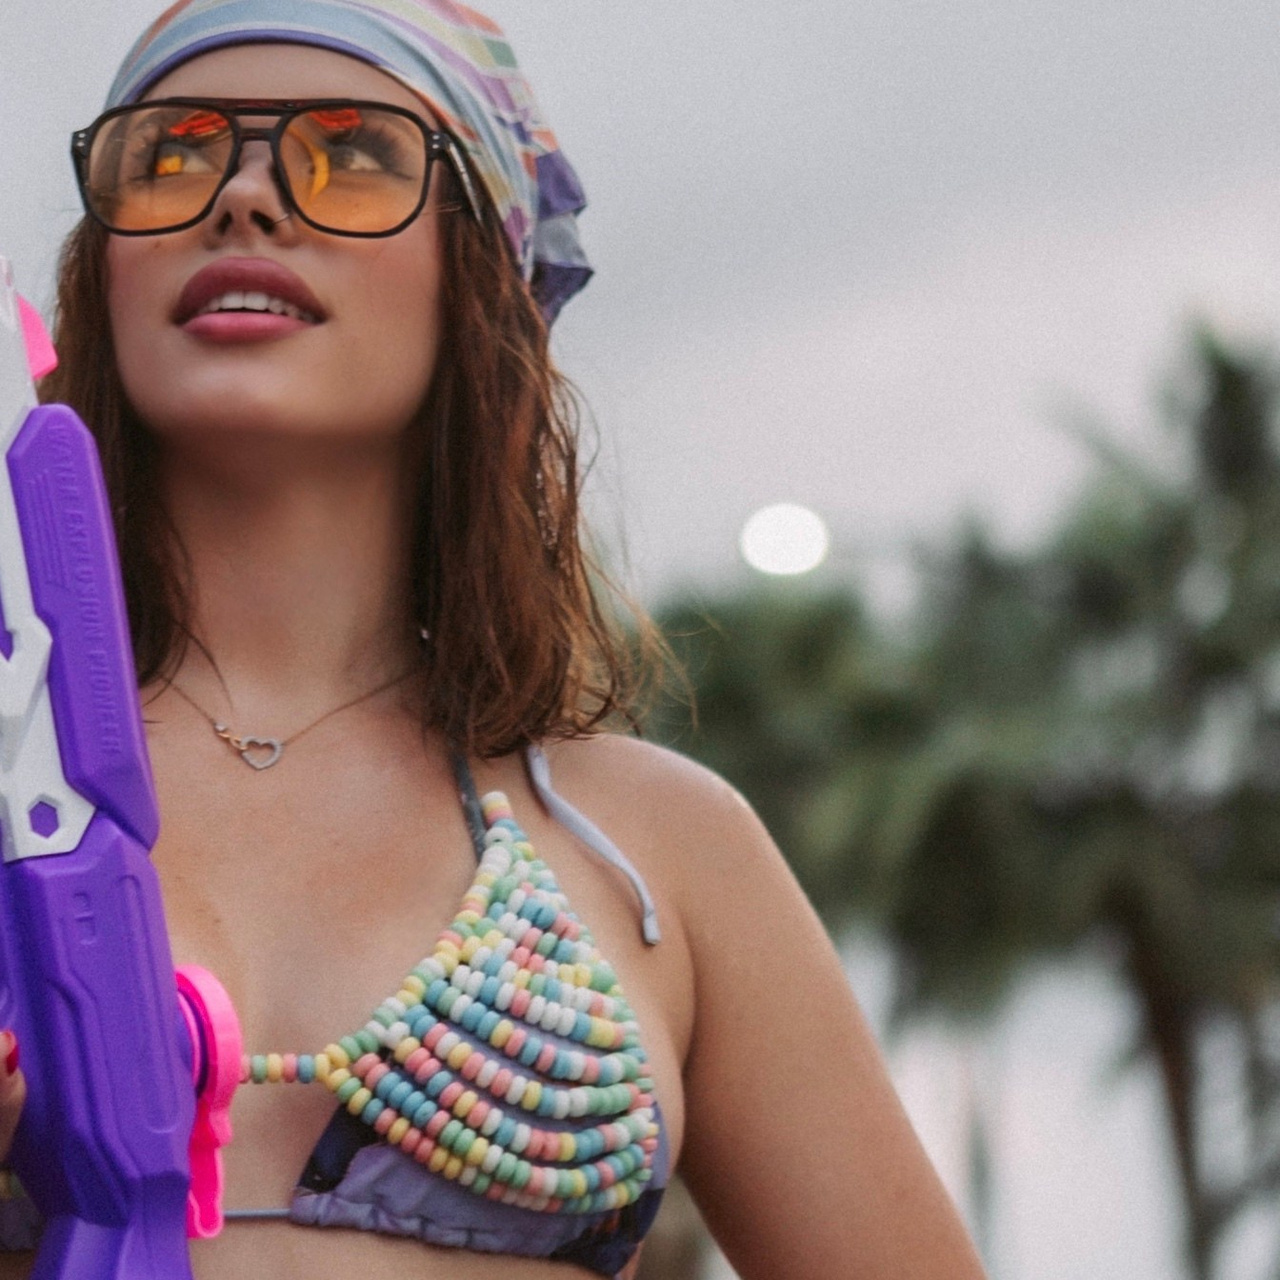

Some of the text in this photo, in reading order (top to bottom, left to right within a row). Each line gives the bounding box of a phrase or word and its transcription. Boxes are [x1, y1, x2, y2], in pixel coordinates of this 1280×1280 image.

[47, 424, 122, 754] WATER EXPLOSION PIONEER
